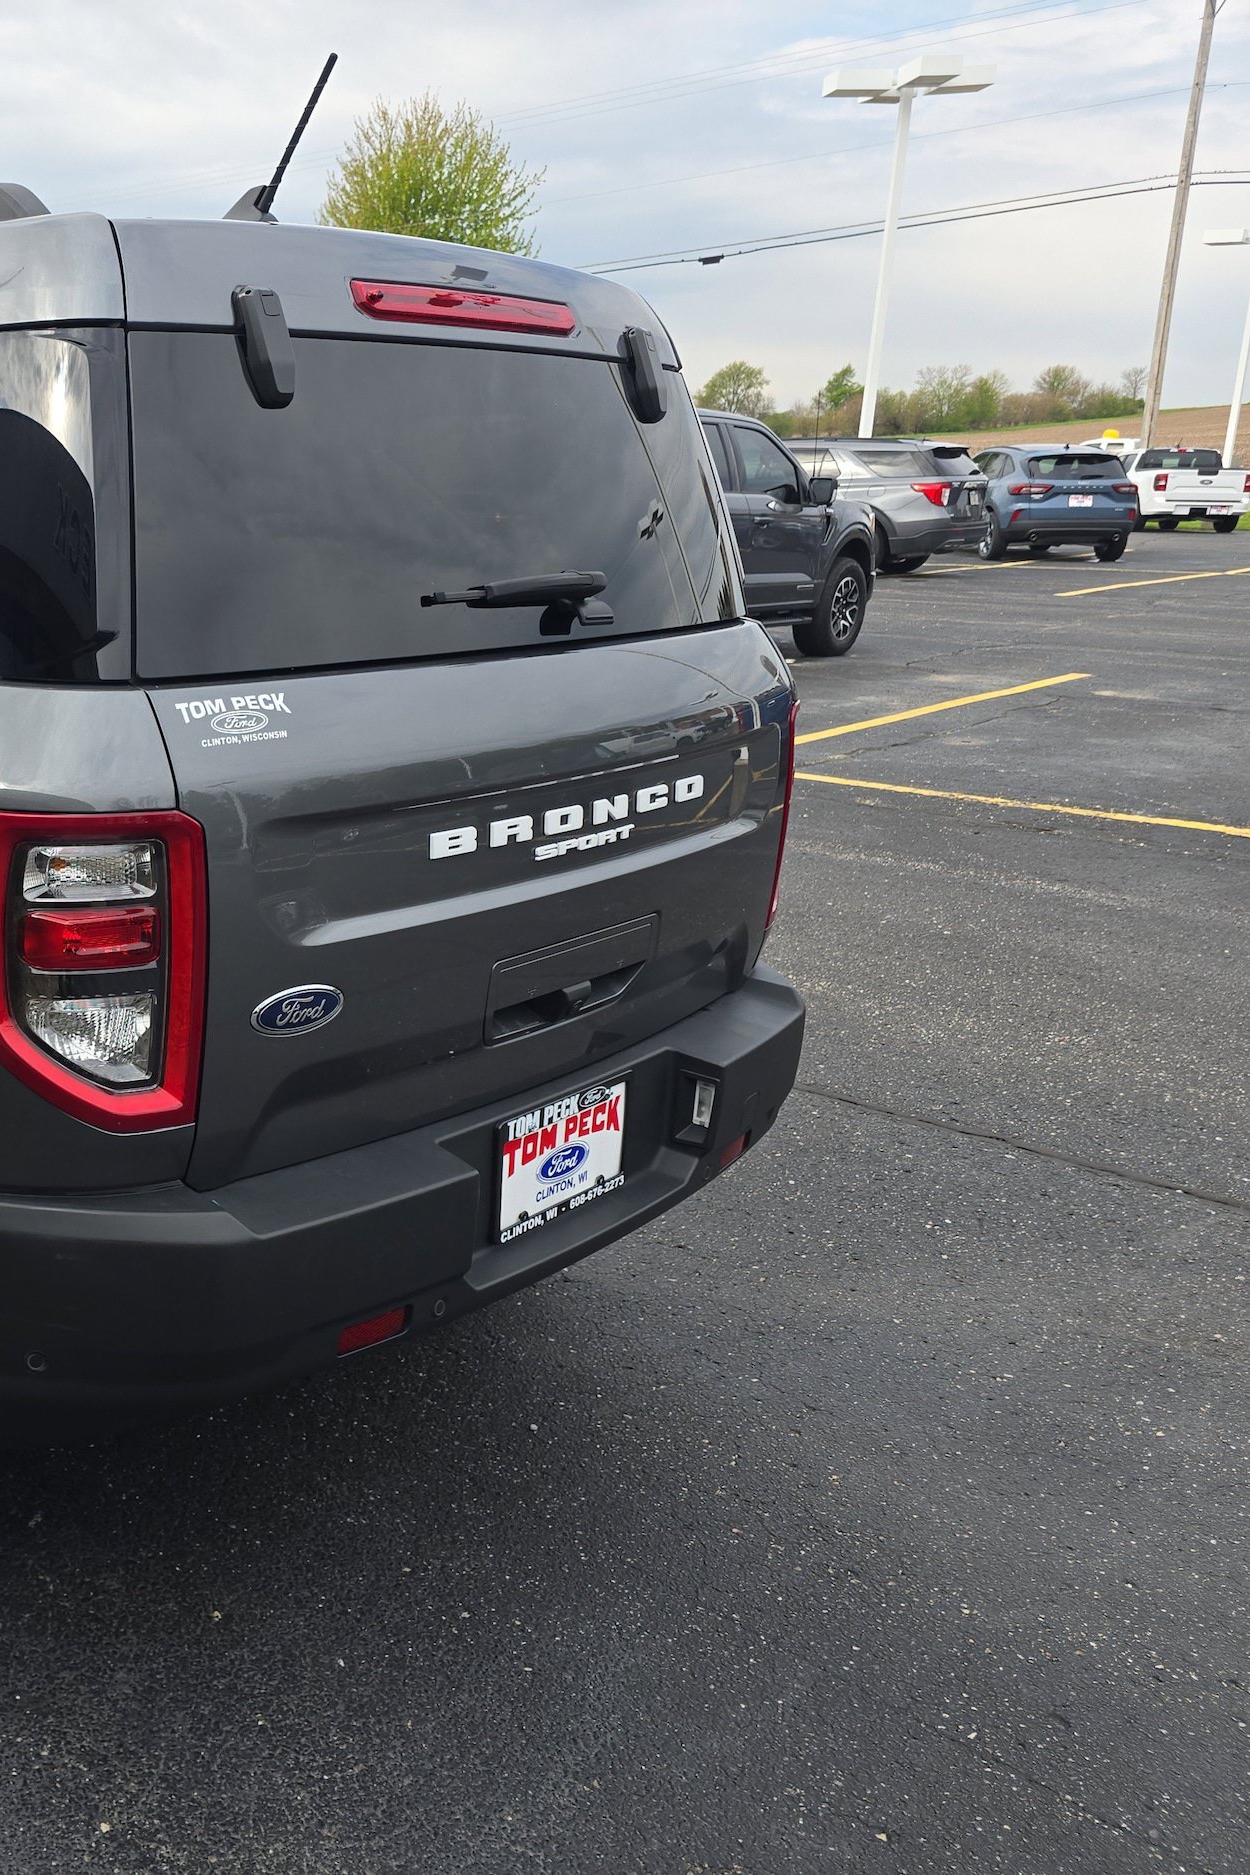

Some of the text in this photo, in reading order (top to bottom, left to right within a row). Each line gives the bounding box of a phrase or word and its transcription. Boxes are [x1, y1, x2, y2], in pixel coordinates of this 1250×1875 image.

[175, 693, 292, 724] TOM PECK
[201, 730, 288, 748] CLINTON, WISCONSIN
[428, 774, 705, 860] BRONCO
[533, 823, 636, 861] SPORT
[503, 1094, 622, 1179] TOM PECK
[507, 1110, 541, 1142] TOM
[543, 1093, 580, 1127] PECK
[535, 1171, 589, 1203] CLINTON, WI
[500, 1215, 545, 1244] CLINTON,
[546, 1206, 558, 1222] WI
